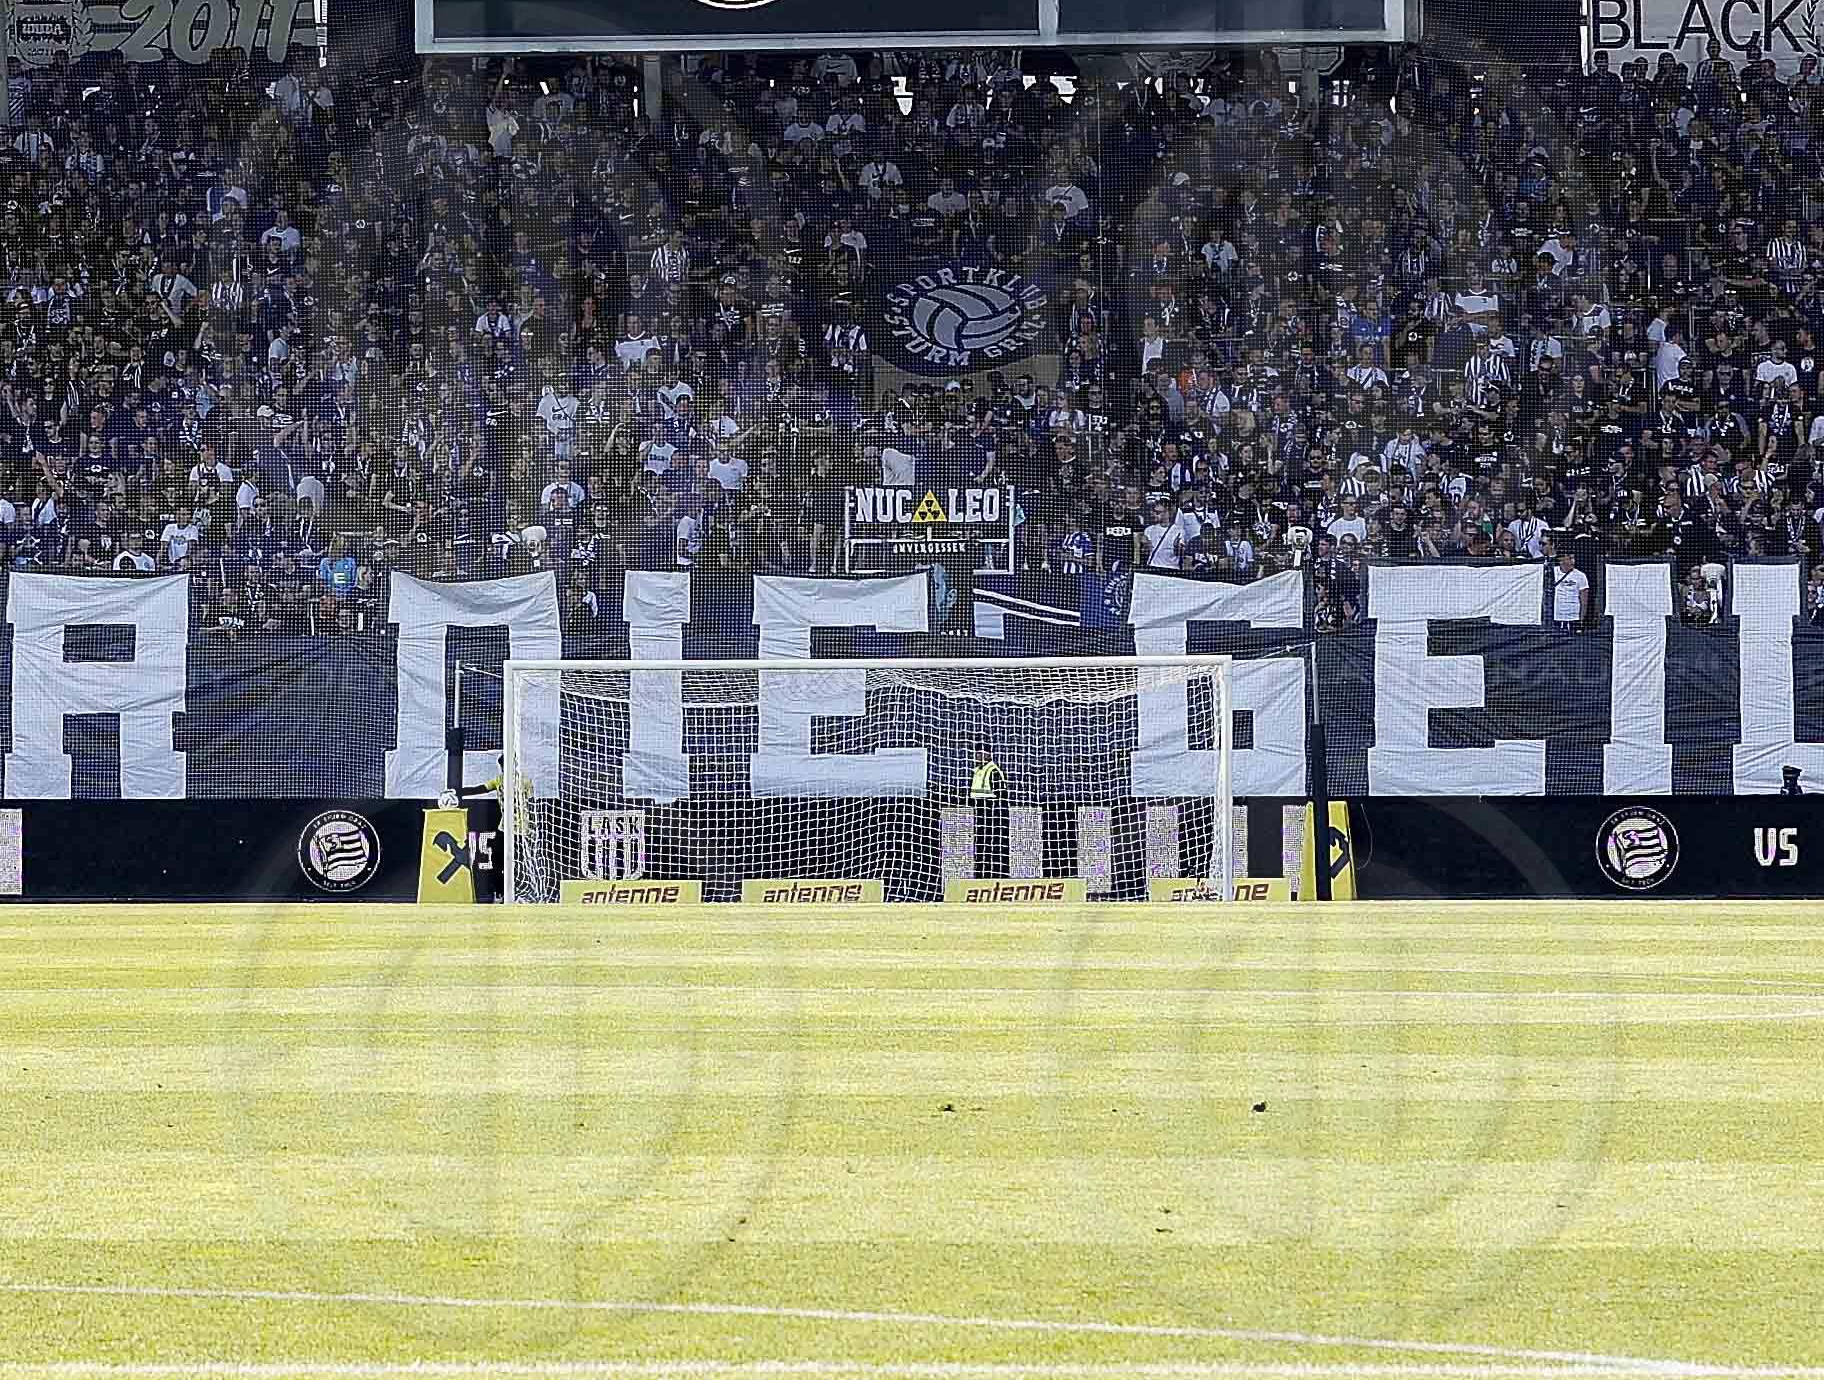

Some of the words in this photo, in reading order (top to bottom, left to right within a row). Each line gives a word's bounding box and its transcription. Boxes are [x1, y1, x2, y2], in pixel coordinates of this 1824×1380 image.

[383, 570, 929, 804] DIE
[1753, 826, 1799, 866] VS
[581, 884, 680, 905] antenne
[762, 882, 863, 904] antenne
[965, 881, 1065, 904] antenne
